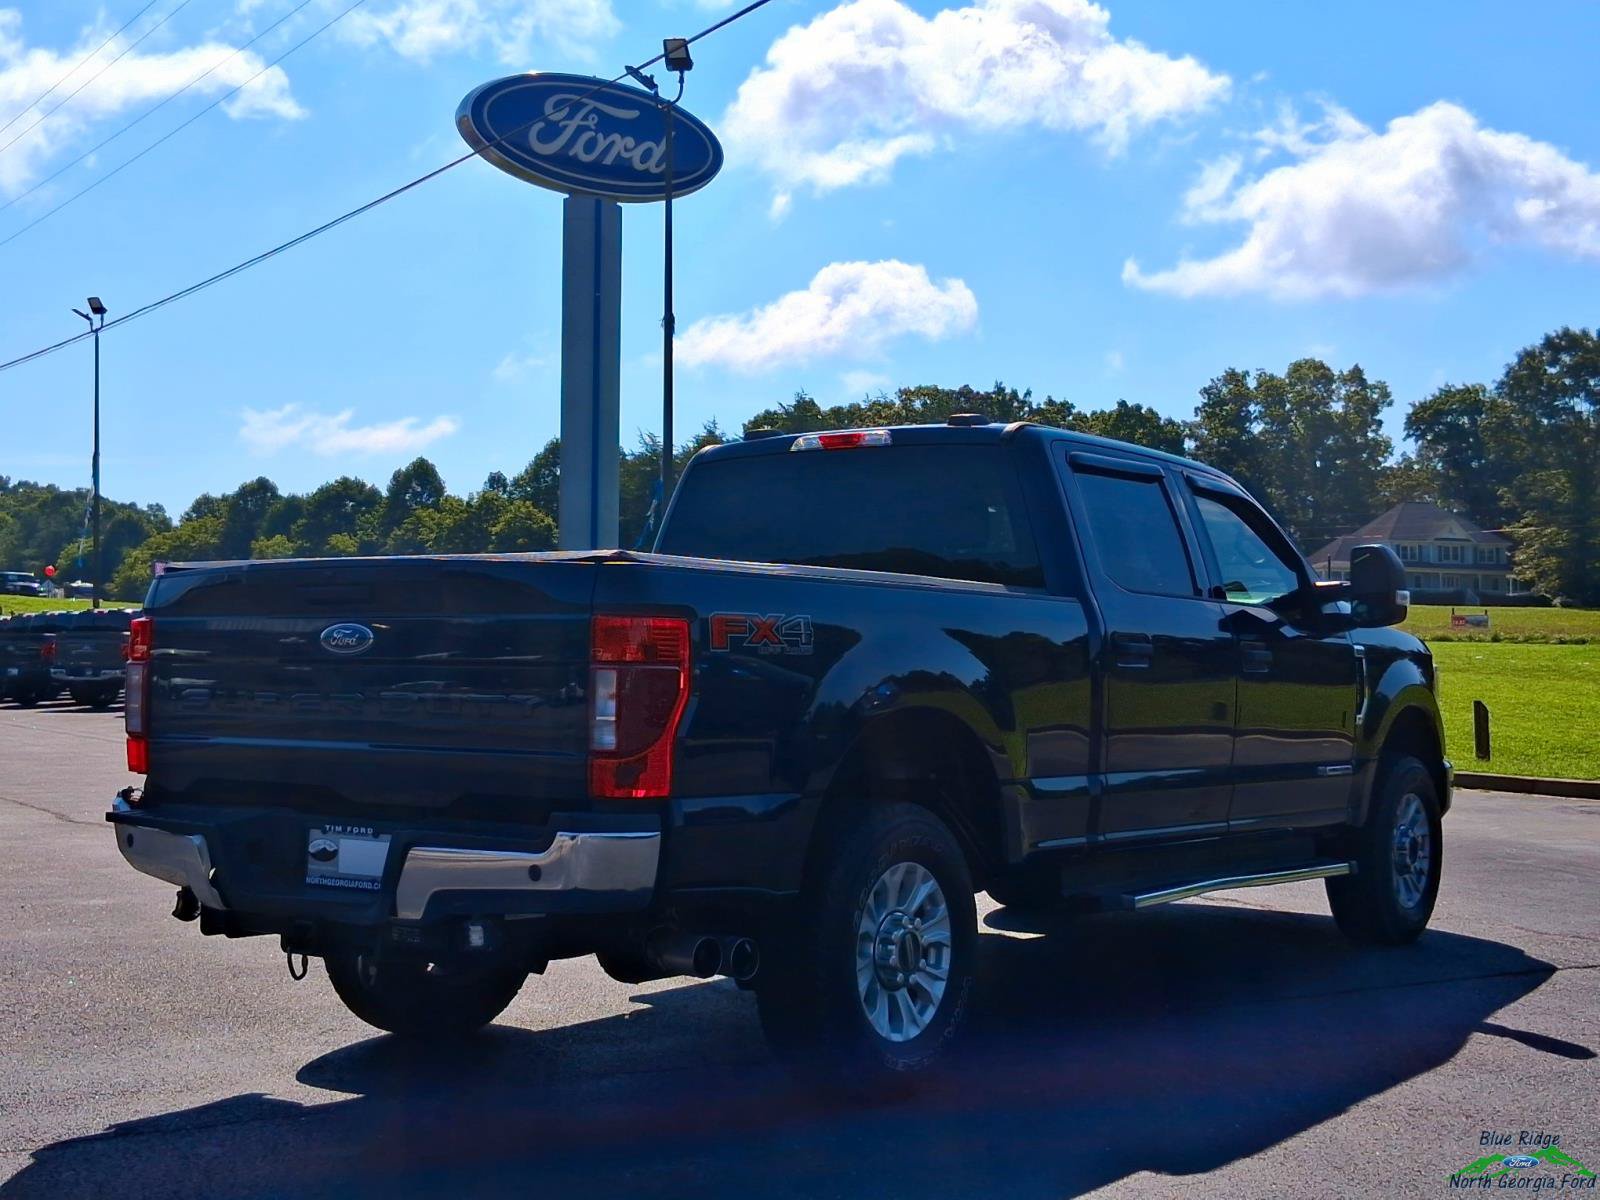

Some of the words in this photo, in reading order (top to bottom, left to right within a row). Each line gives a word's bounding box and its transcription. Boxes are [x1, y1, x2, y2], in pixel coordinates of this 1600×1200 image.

[528, 93, 676, 174] Ford
[330, 628, 359, 646] Ford
[709, 611, 814, 652] FX4
[325, 824, 342, 832] TIM
[347, 826, 374, 834] FORD
